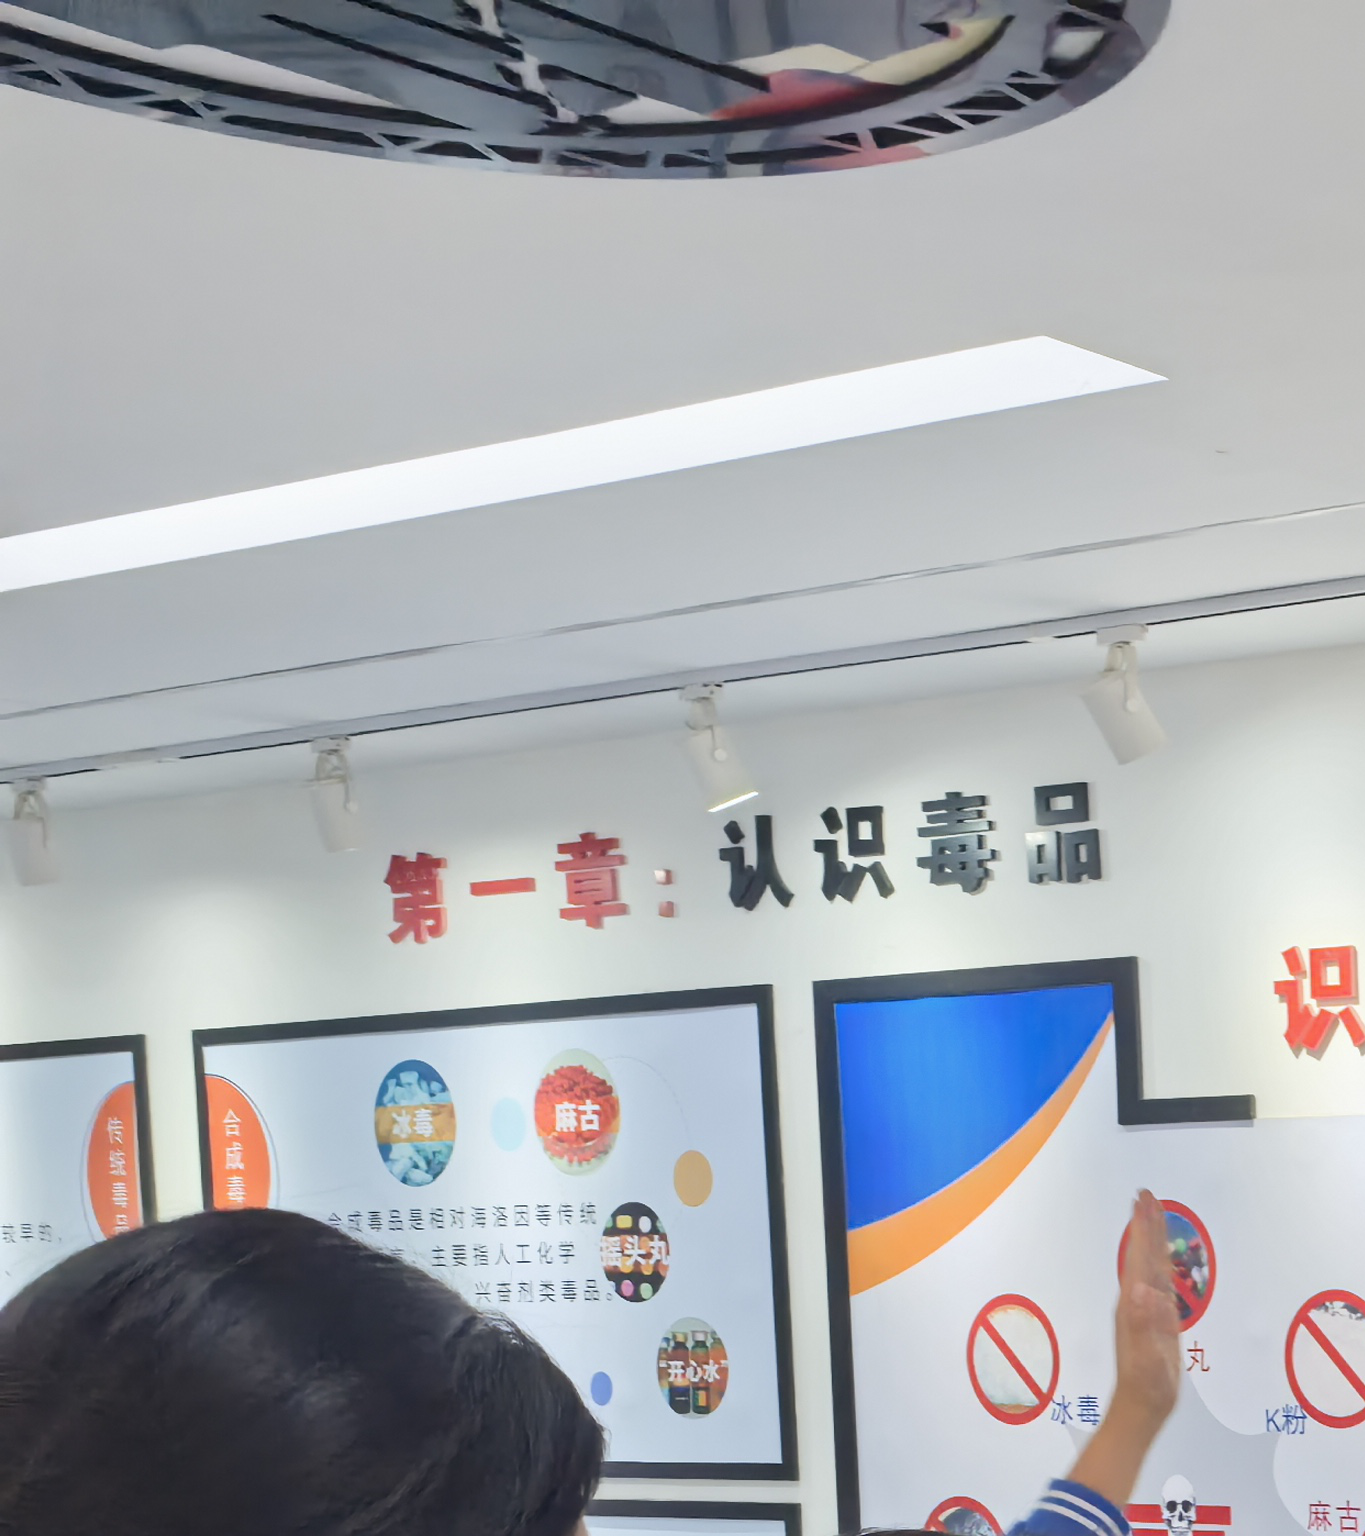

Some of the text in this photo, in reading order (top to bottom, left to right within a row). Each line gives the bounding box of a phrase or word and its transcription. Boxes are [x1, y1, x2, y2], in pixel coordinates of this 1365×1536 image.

[555, 1100, 600, 1132] 麻古
[600, 1235, 670, 1268] 摇头丸
[1052, 1395, 1101, 1426] 冰毒
[1266, 1404, 1307, 1435] K粉
[1308, 1500, 1361, 1532] 麻古
